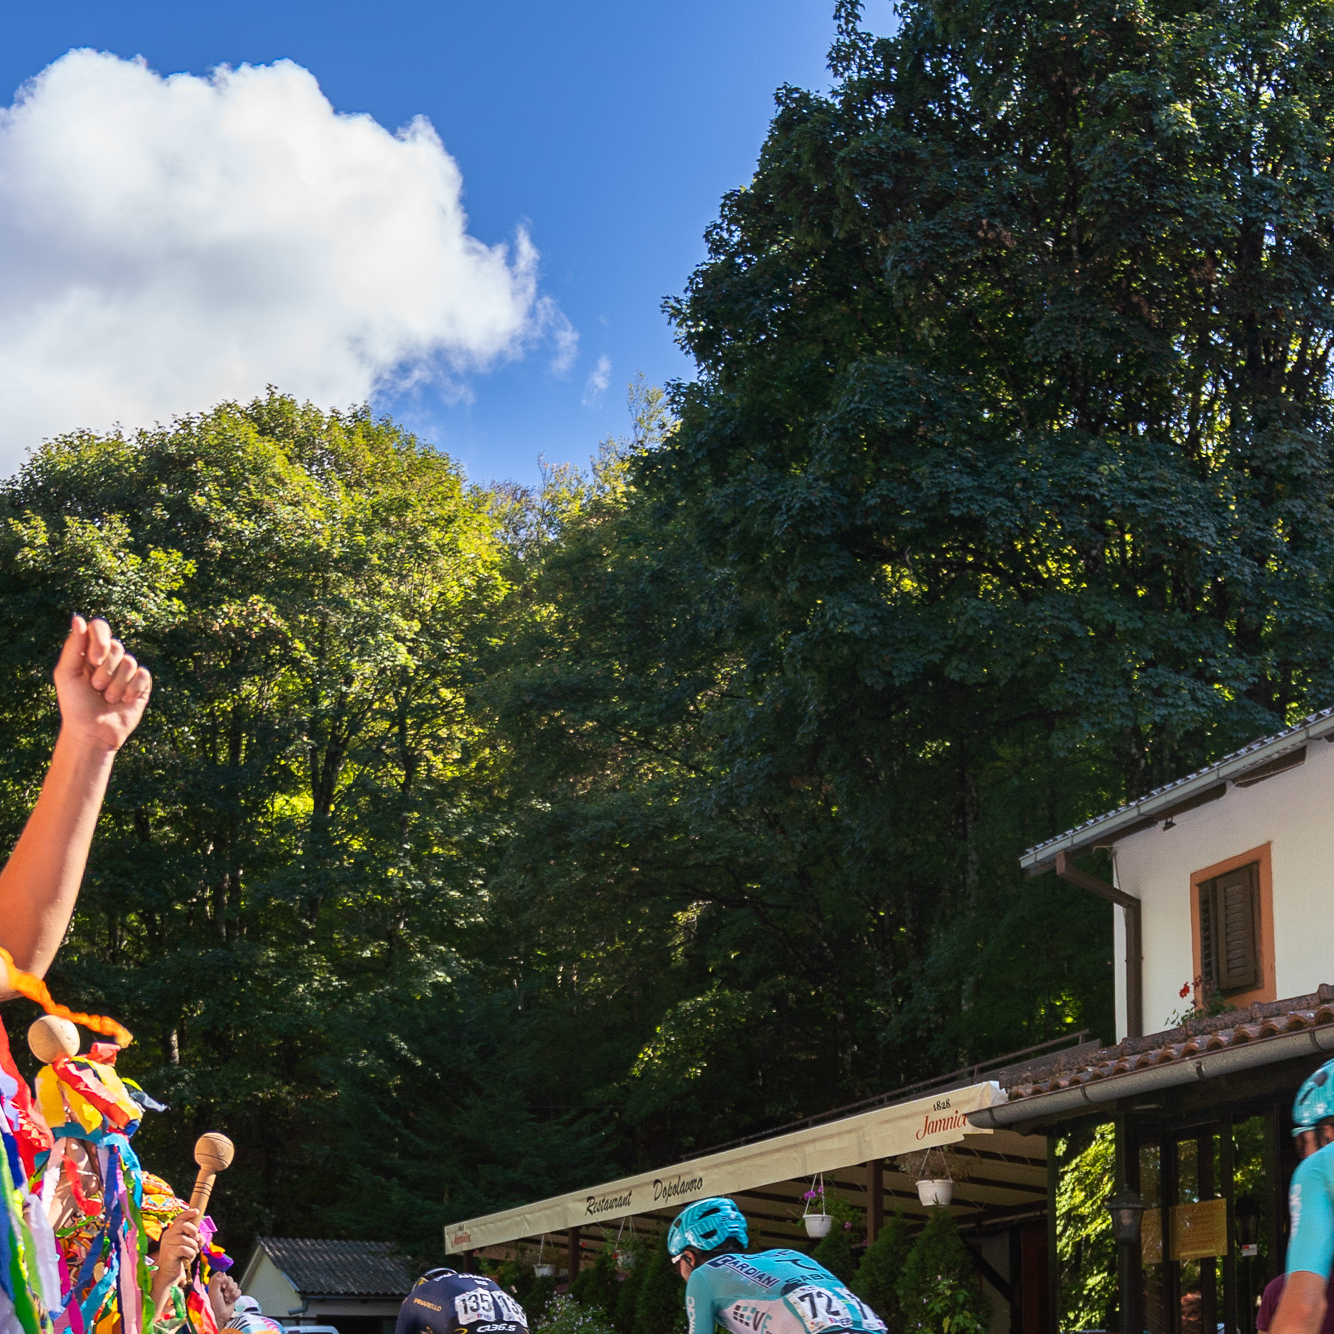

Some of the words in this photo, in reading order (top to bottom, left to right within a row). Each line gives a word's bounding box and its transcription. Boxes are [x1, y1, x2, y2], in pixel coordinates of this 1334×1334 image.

[932, 1098, 951, 1112] 1828
[584, 1189, 633, 1216] Restaurant
[652, 1175, 704, 1204] Dopolavoro
[413, 1297, 443, 1312] PINARELLO
[460, 1293, 495, 1315] 135
[798, 1290, 842, 1320] 72
[476, 1323, 517, 1333] Q36.5
